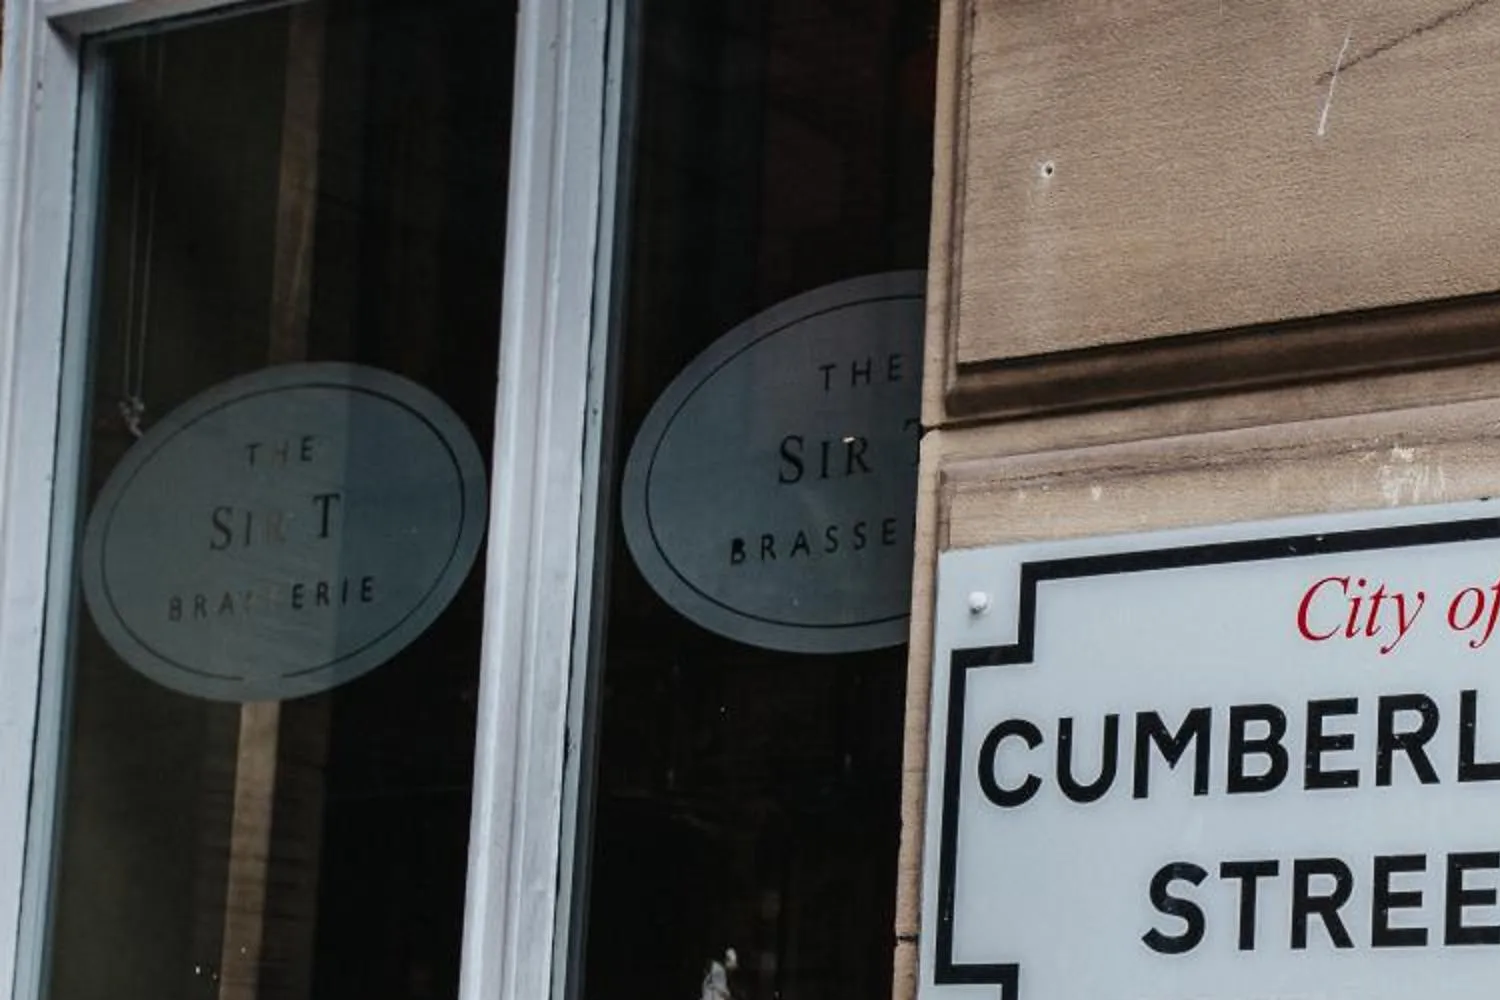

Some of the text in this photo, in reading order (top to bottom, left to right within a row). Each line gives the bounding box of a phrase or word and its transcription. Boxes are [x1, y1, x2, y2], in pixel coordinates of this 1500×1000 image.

[818, 352, 904, 392] THE
[243, 433, 317, 469] THE
[777, 433, 875, 487] SIR
[311, 492, 342, 540] T
[729, 516, 899, 568] BRASSE
[167, 574, 377, 624] BRAERIE
[1295, 575, 1427, 655] City
